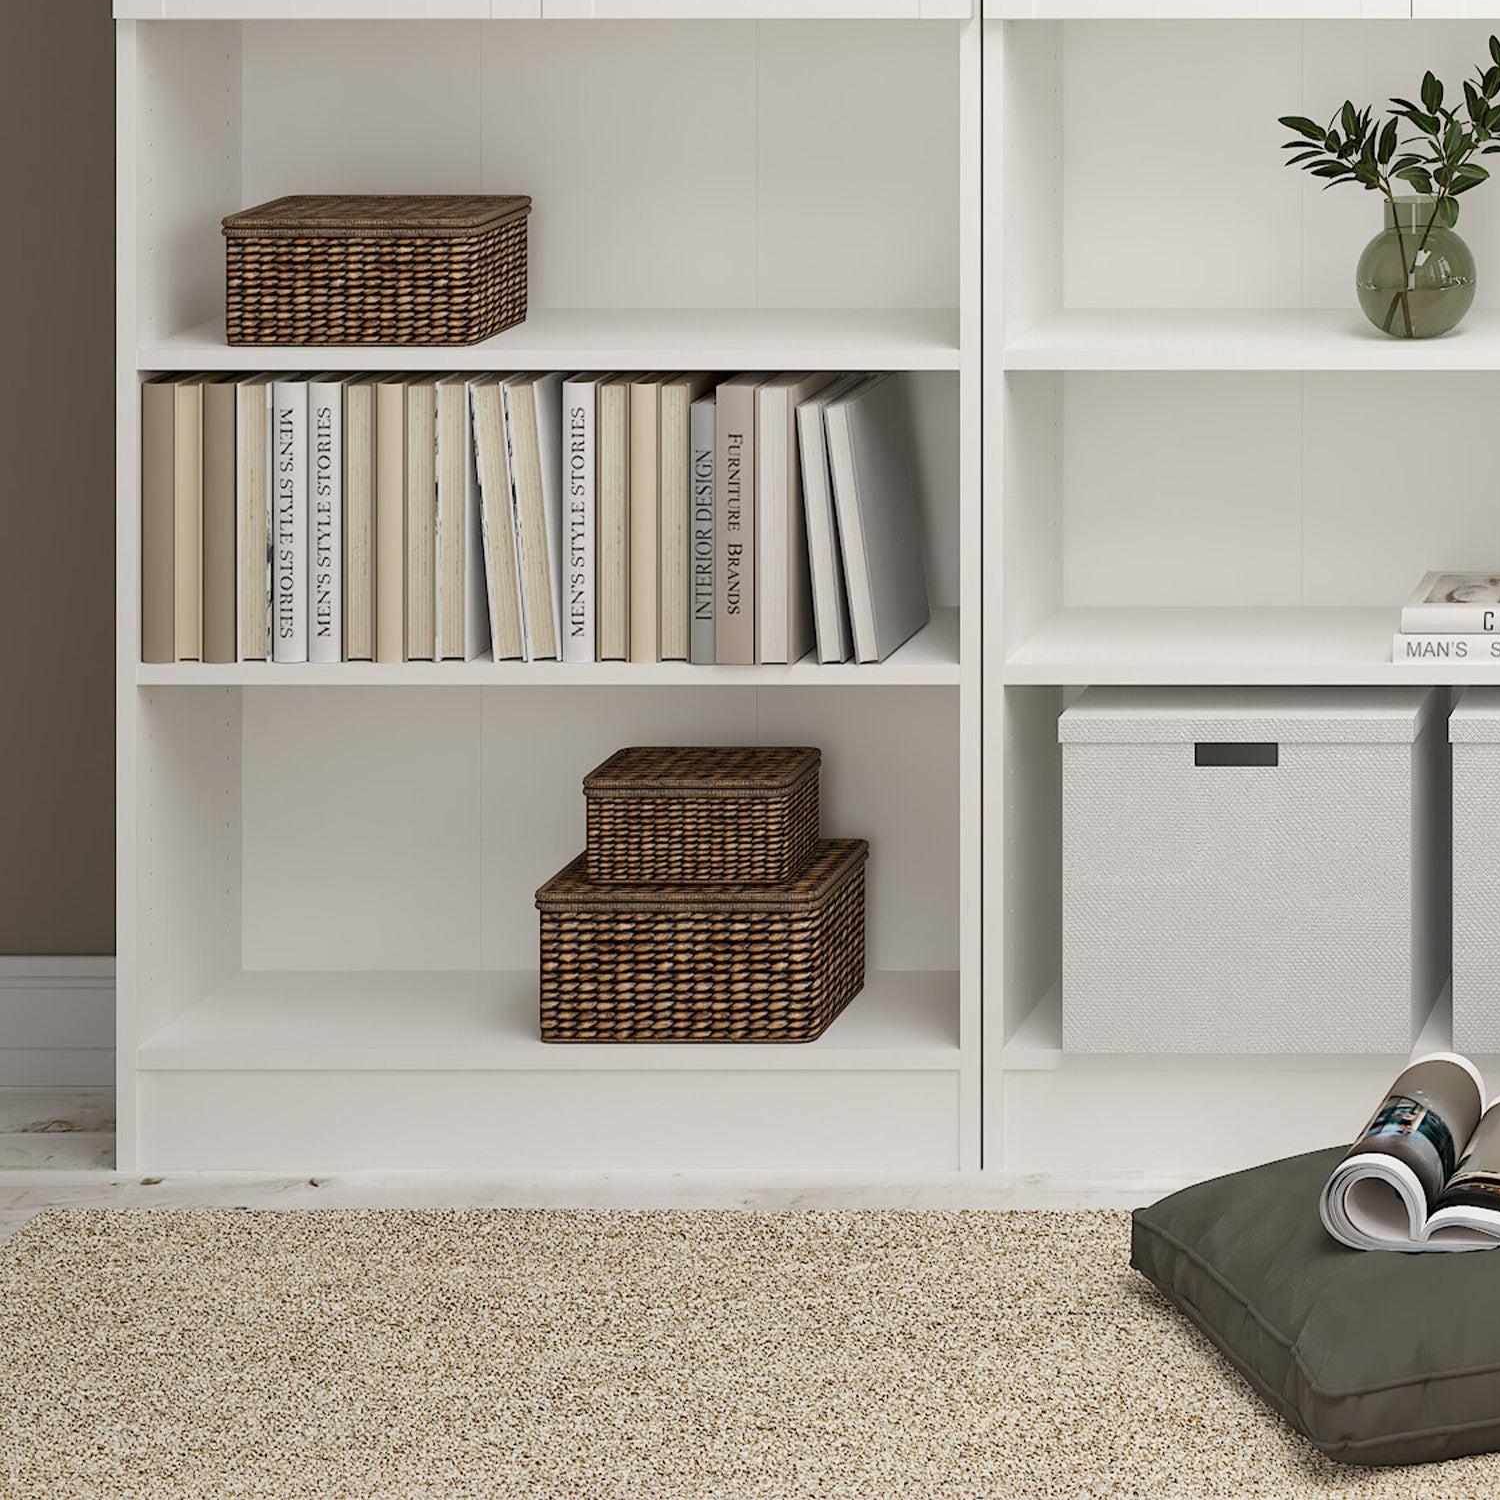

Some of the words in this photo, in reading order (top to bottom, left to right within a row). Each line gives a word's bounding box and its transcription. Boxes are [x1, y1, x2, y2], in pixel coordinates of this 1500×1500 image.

[317, 407, 331, 495] STORIES
[571, 407, 585, 498] STORIES
[696, 449, 712, 522] DESIGN
[280, 479, 293, 544] STYLE
[317, 501, 331, 567] STYLE
[571, 503, 585, 568] STYLE
[280, 550, 293, 639] STORIES
[696, 527, 712, 621] INTERIOR
